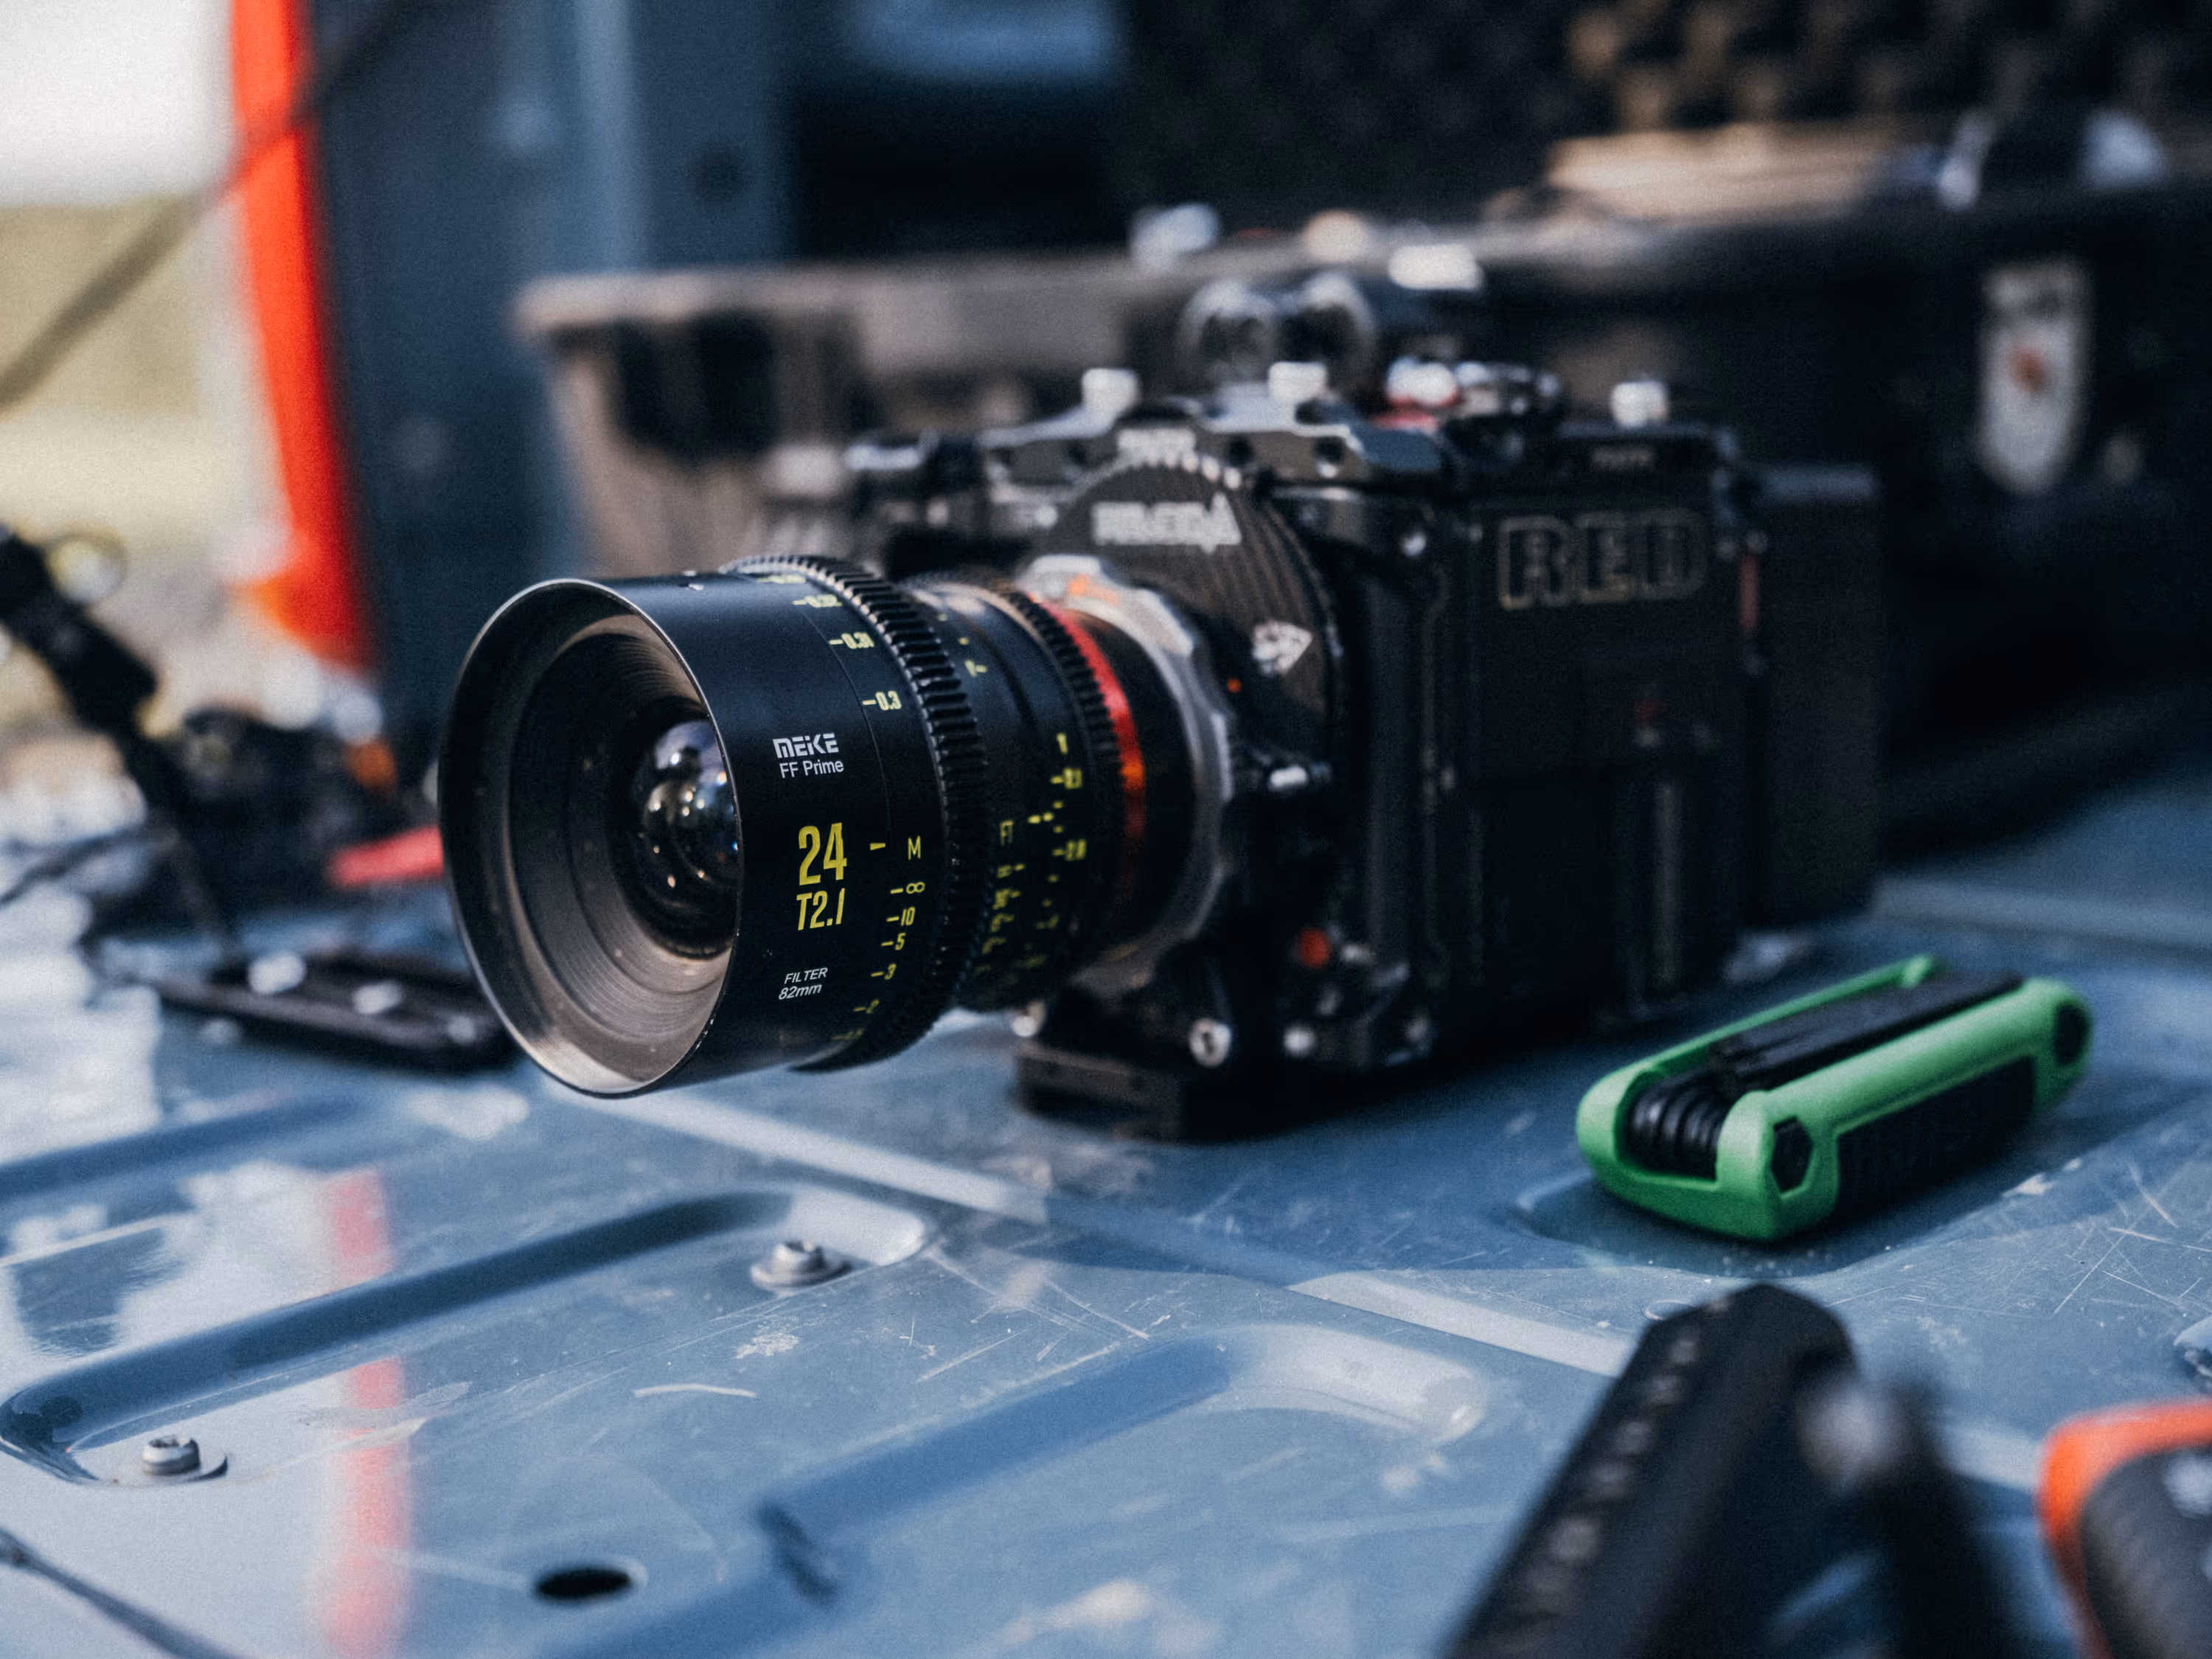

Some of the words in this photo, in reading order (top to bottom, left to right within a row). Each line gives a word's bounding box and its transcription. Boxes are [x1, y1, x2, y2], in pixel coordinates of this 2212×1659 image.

[875, 690, 902, 711] 0.3
[779, 762, 799, 779] FF
[802, 759, 844, 777] Prime
[799, 822, 847, 886] 24
[908, 835, 921, 860] M
[796, 888, 846, 931] T2.1
[900, 906, 916, 927] 10
[894, 933, 905, 951] 5
[784, 967, 828, 985] FILTER
[884, 963, 897, 980] 3
[779, 984, 823, 1001] 82mm
